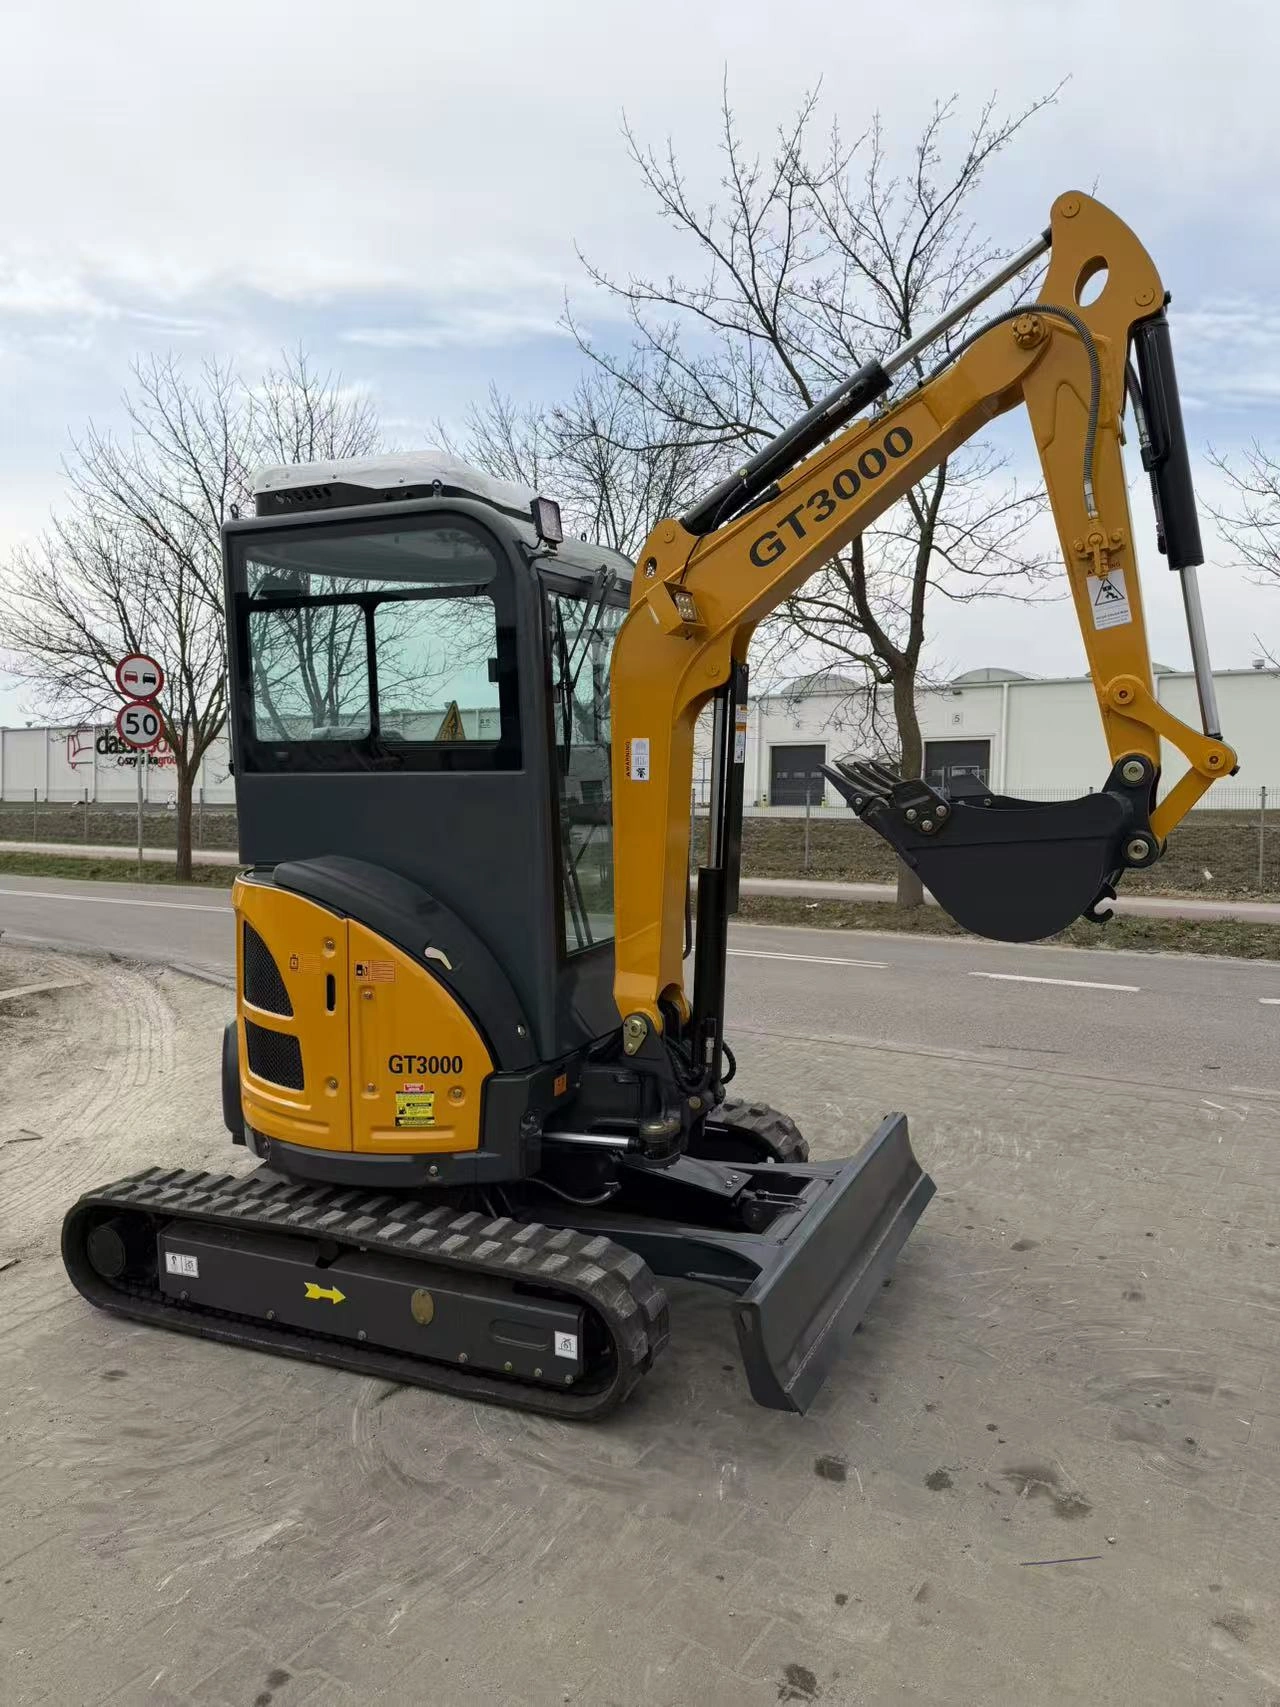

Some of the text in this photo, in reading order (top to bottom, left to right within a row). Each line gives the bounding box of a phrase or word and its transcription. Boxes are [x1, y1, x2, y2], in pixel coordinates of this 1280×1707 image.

[749, 426, 913, 567] GT3000
[125, 713, 158, 735] 50
[388, 1054, 463, 1074] GT3000
